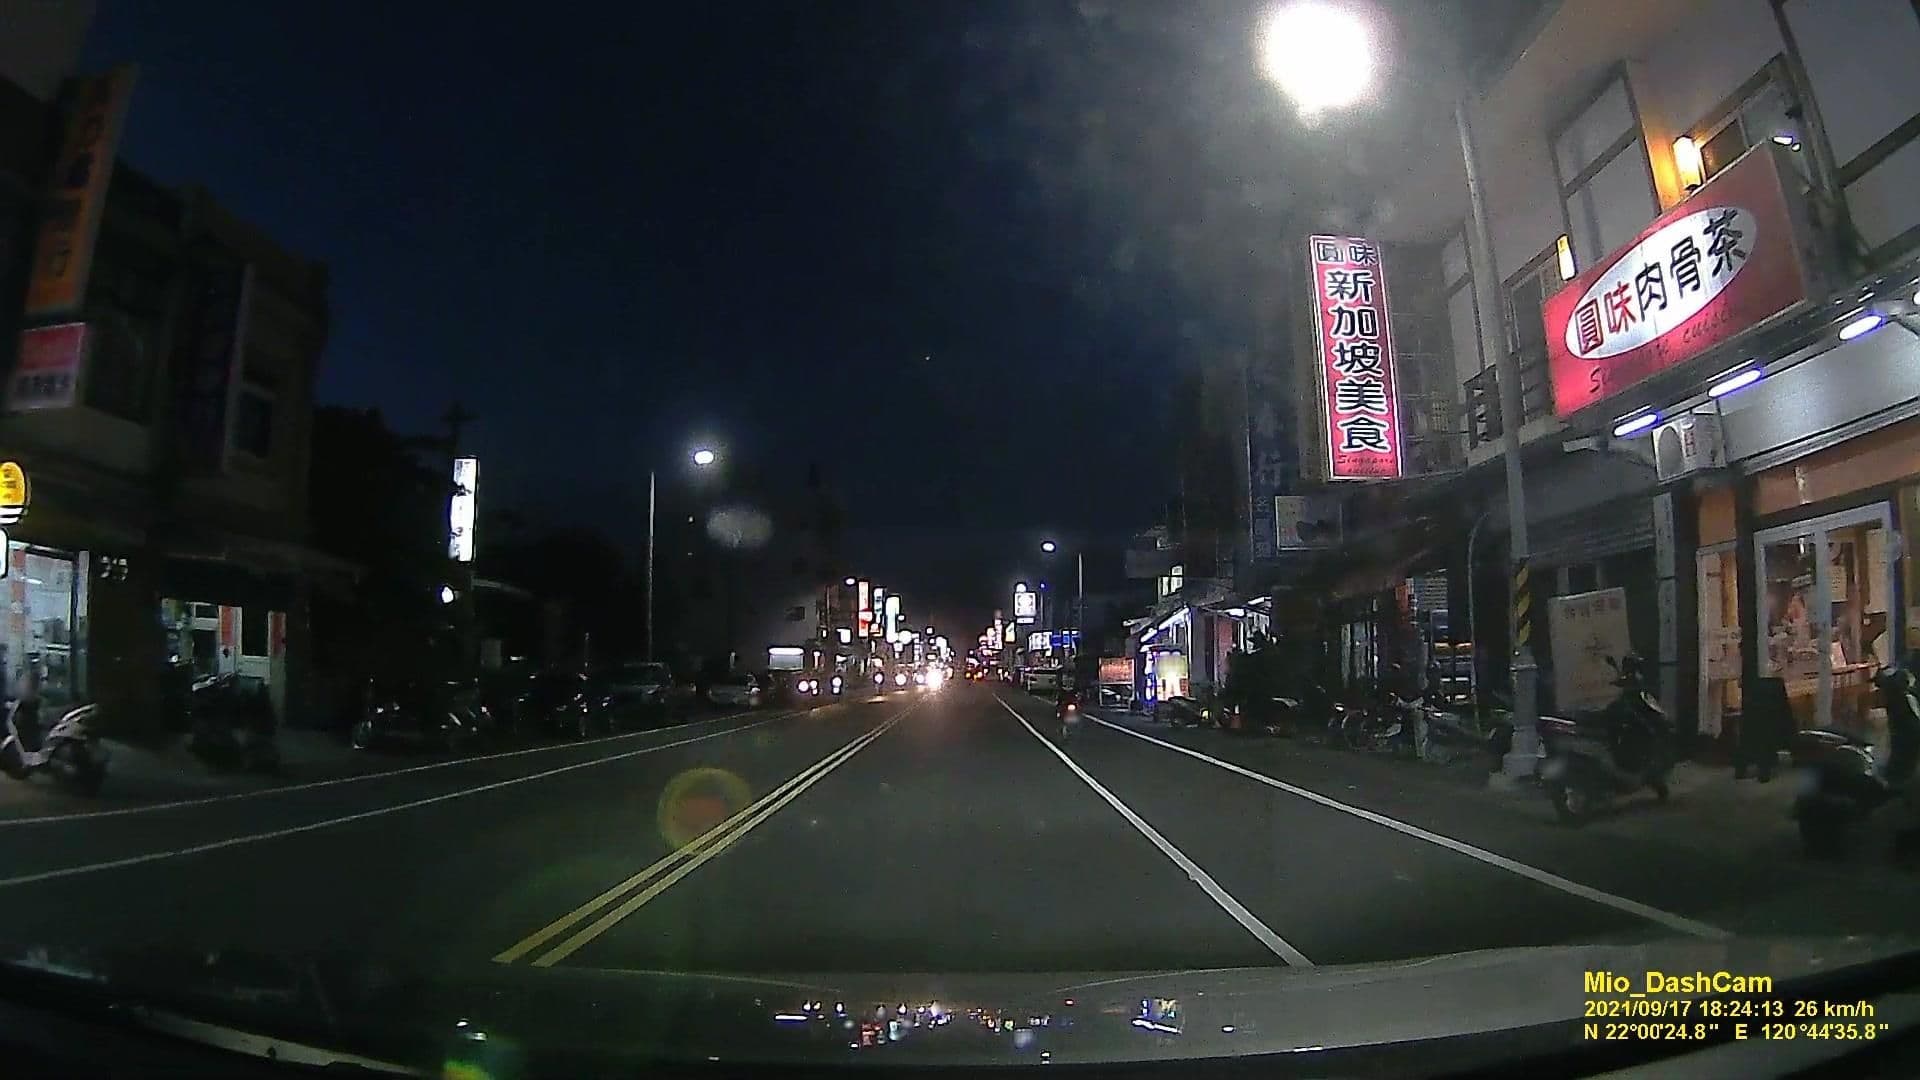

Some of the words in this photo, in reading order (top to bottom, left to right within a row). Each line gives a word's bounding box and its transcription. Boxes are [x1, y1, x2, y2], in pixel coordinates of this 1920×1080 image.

[1326, 269, 1390, 451] 新加坡美食
[1575, 209, 1746, 355] 圓味肉骨茶
